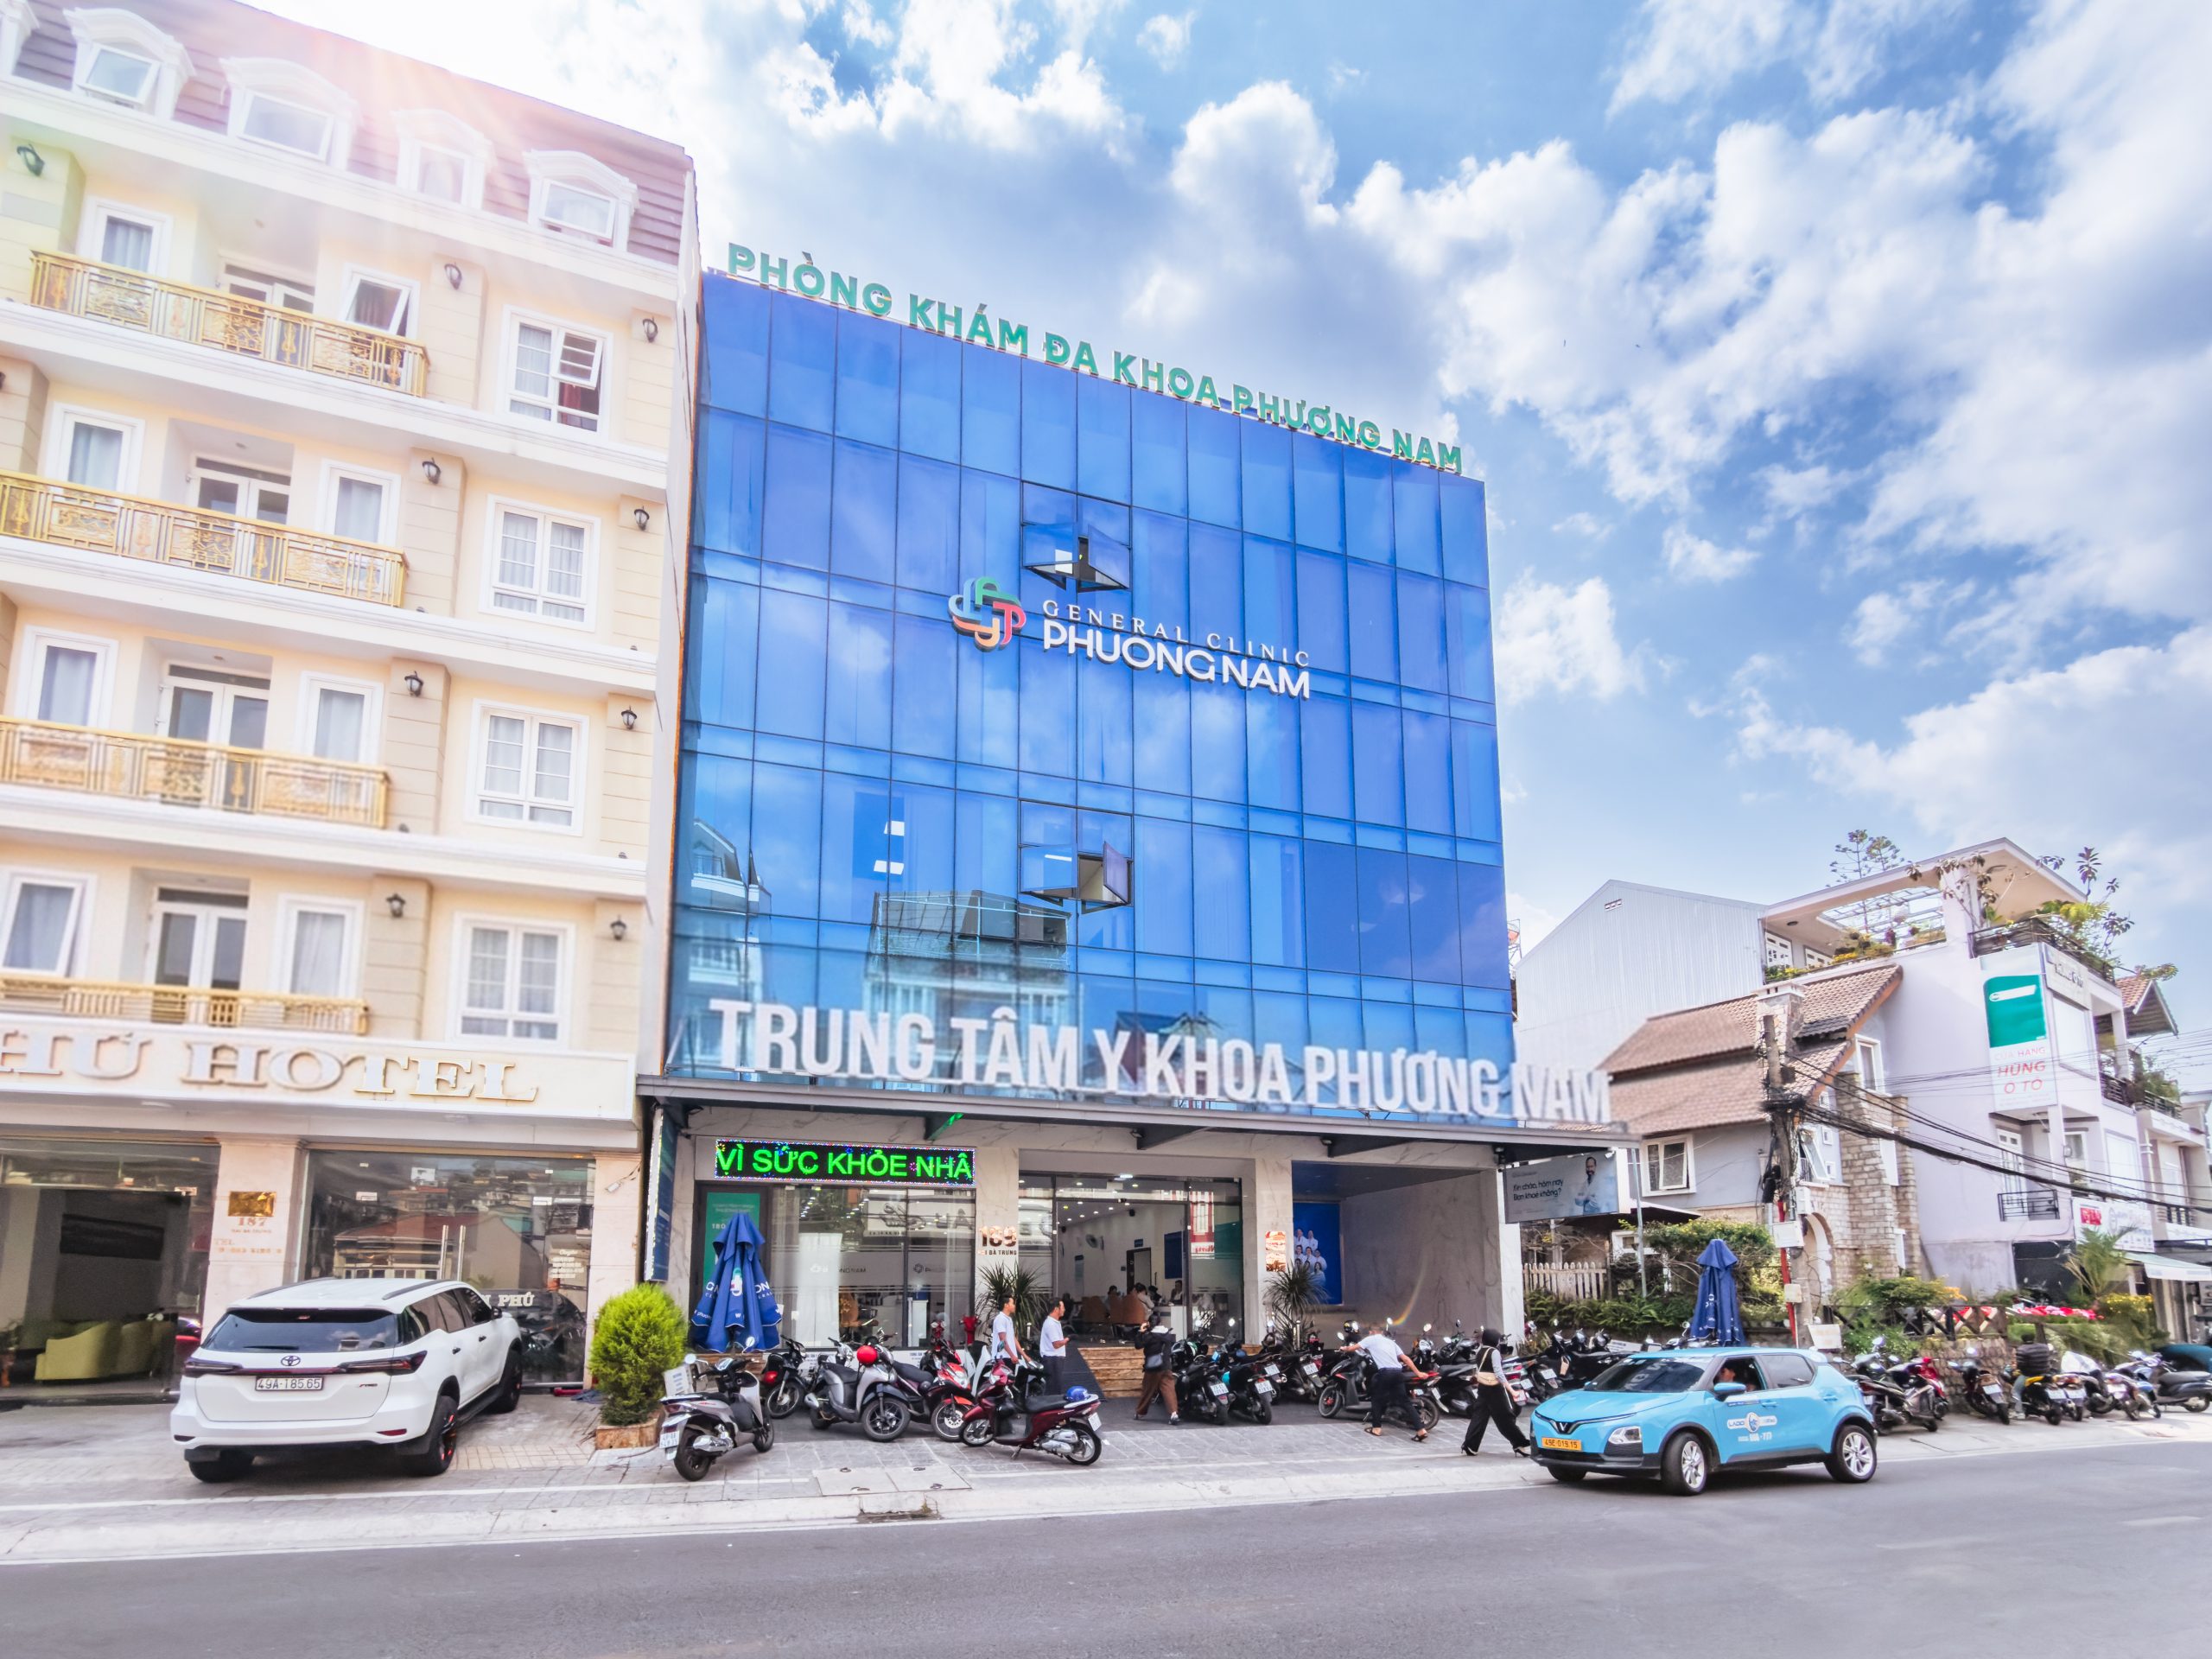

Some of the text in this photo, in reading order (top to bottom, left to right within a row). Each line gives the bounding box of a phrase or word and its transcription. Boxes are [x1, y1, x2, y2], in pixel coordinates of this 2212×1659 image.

[728, 242, 1463, 474] PHÒNG KHÁM ĐA KHOA PHƯƠNG NAM
[1043, 600, 1309, 667] GENERAL CLINIC
[181, 1040, 539, 1102] HOTEL
[709, 999, 1611, 1123] TRUNG TÂM Y KHOA PHƯƠNG NAM
[716, 1144, 744, 1172] VÌ
[752, 1144, 819, 1174] SỨC
[827, 1149, 907, 1177] KHỎE
[497, 1291, 535, 1306] PHÚ
